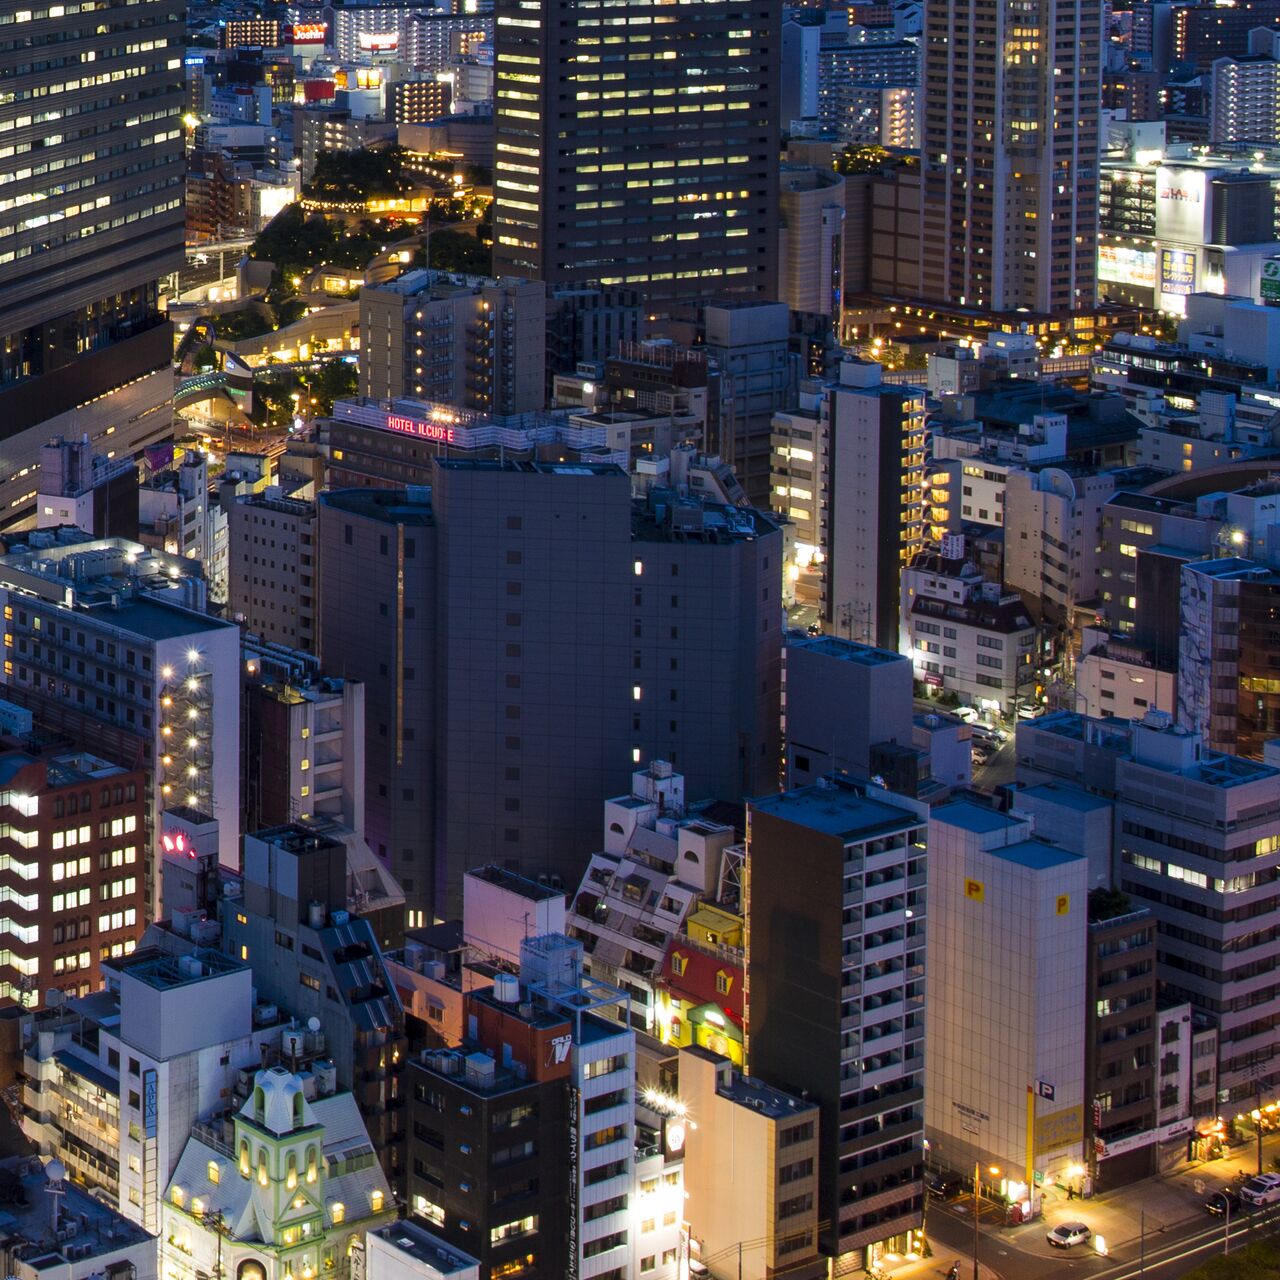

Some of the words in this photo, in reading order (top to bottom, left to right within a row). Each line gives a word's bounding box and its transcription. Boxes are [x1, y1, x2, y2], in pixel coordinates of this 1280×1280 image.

[294, 30, 324, 40] Joshin
[388, 416, 416, 433] HOTEL
[418, 423, 454, 441] ILCUOE
[967, 881, 980, 896] P
[1057, 897, 1067, 913] P
[1041, 1083, 1053, 1097] P
